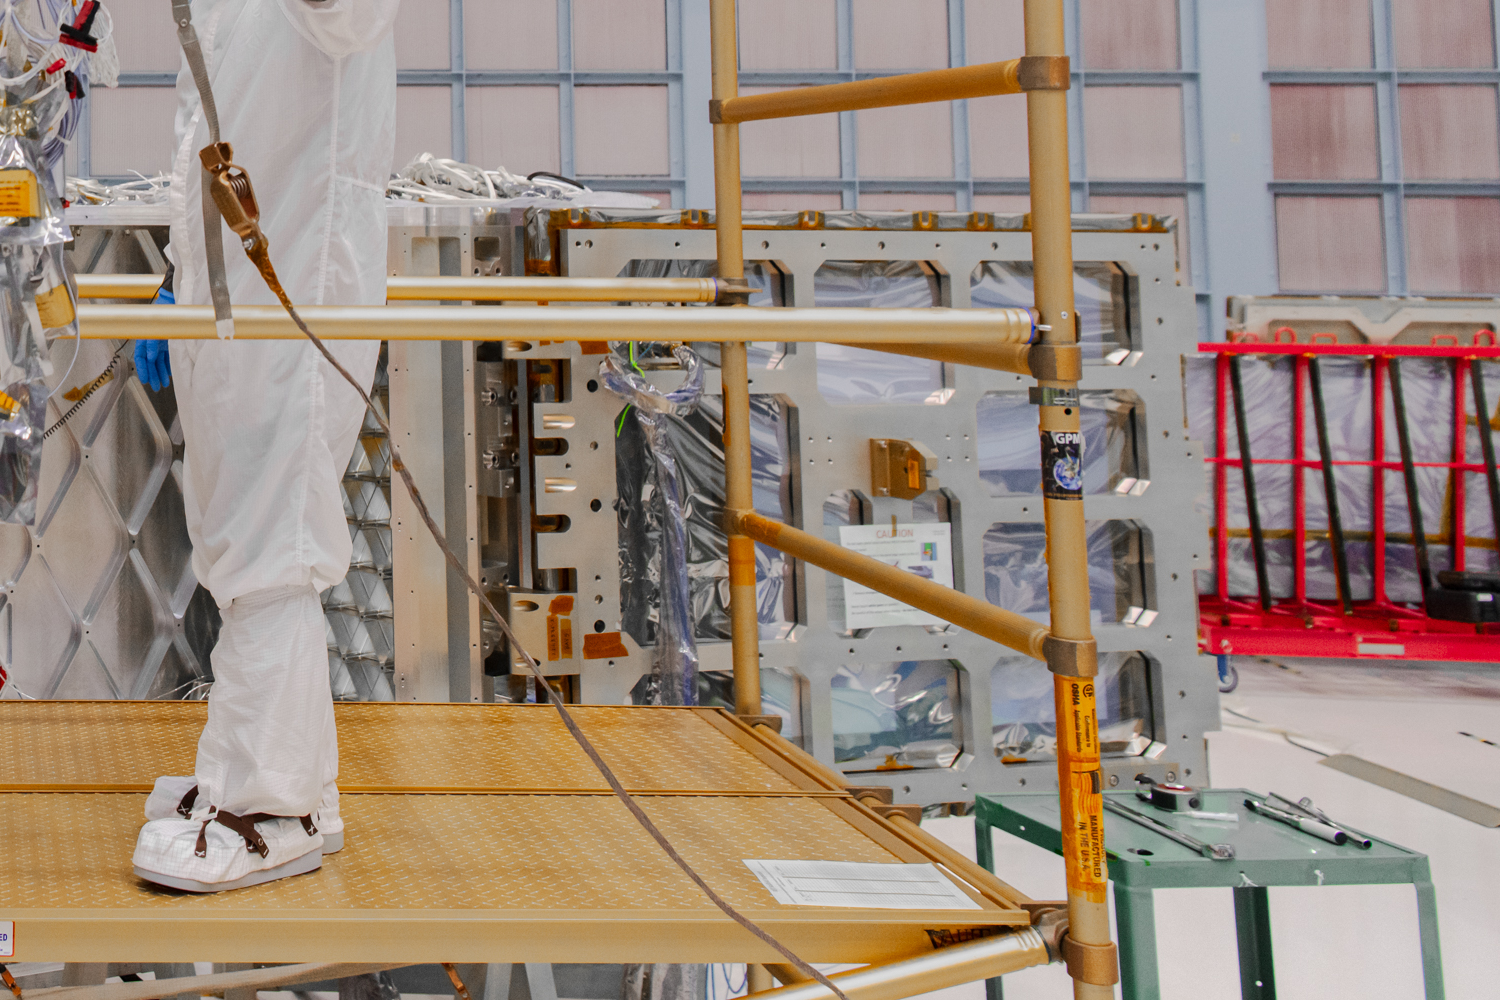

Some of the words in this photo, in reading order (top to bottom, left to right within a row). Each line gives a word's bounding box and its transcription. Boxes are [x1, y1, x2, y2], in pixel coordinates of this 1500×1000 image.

[1055, 433, 1080, 444] GPM
[876, 529, 914, 538] CAUION
[1071, 683, 1080, 705] OSHA
[1079, 821, 1086, 830] IN
[1080, 832, 1089, 847] THE
[1090, 815, 1101, 878] MANUFACTURED
